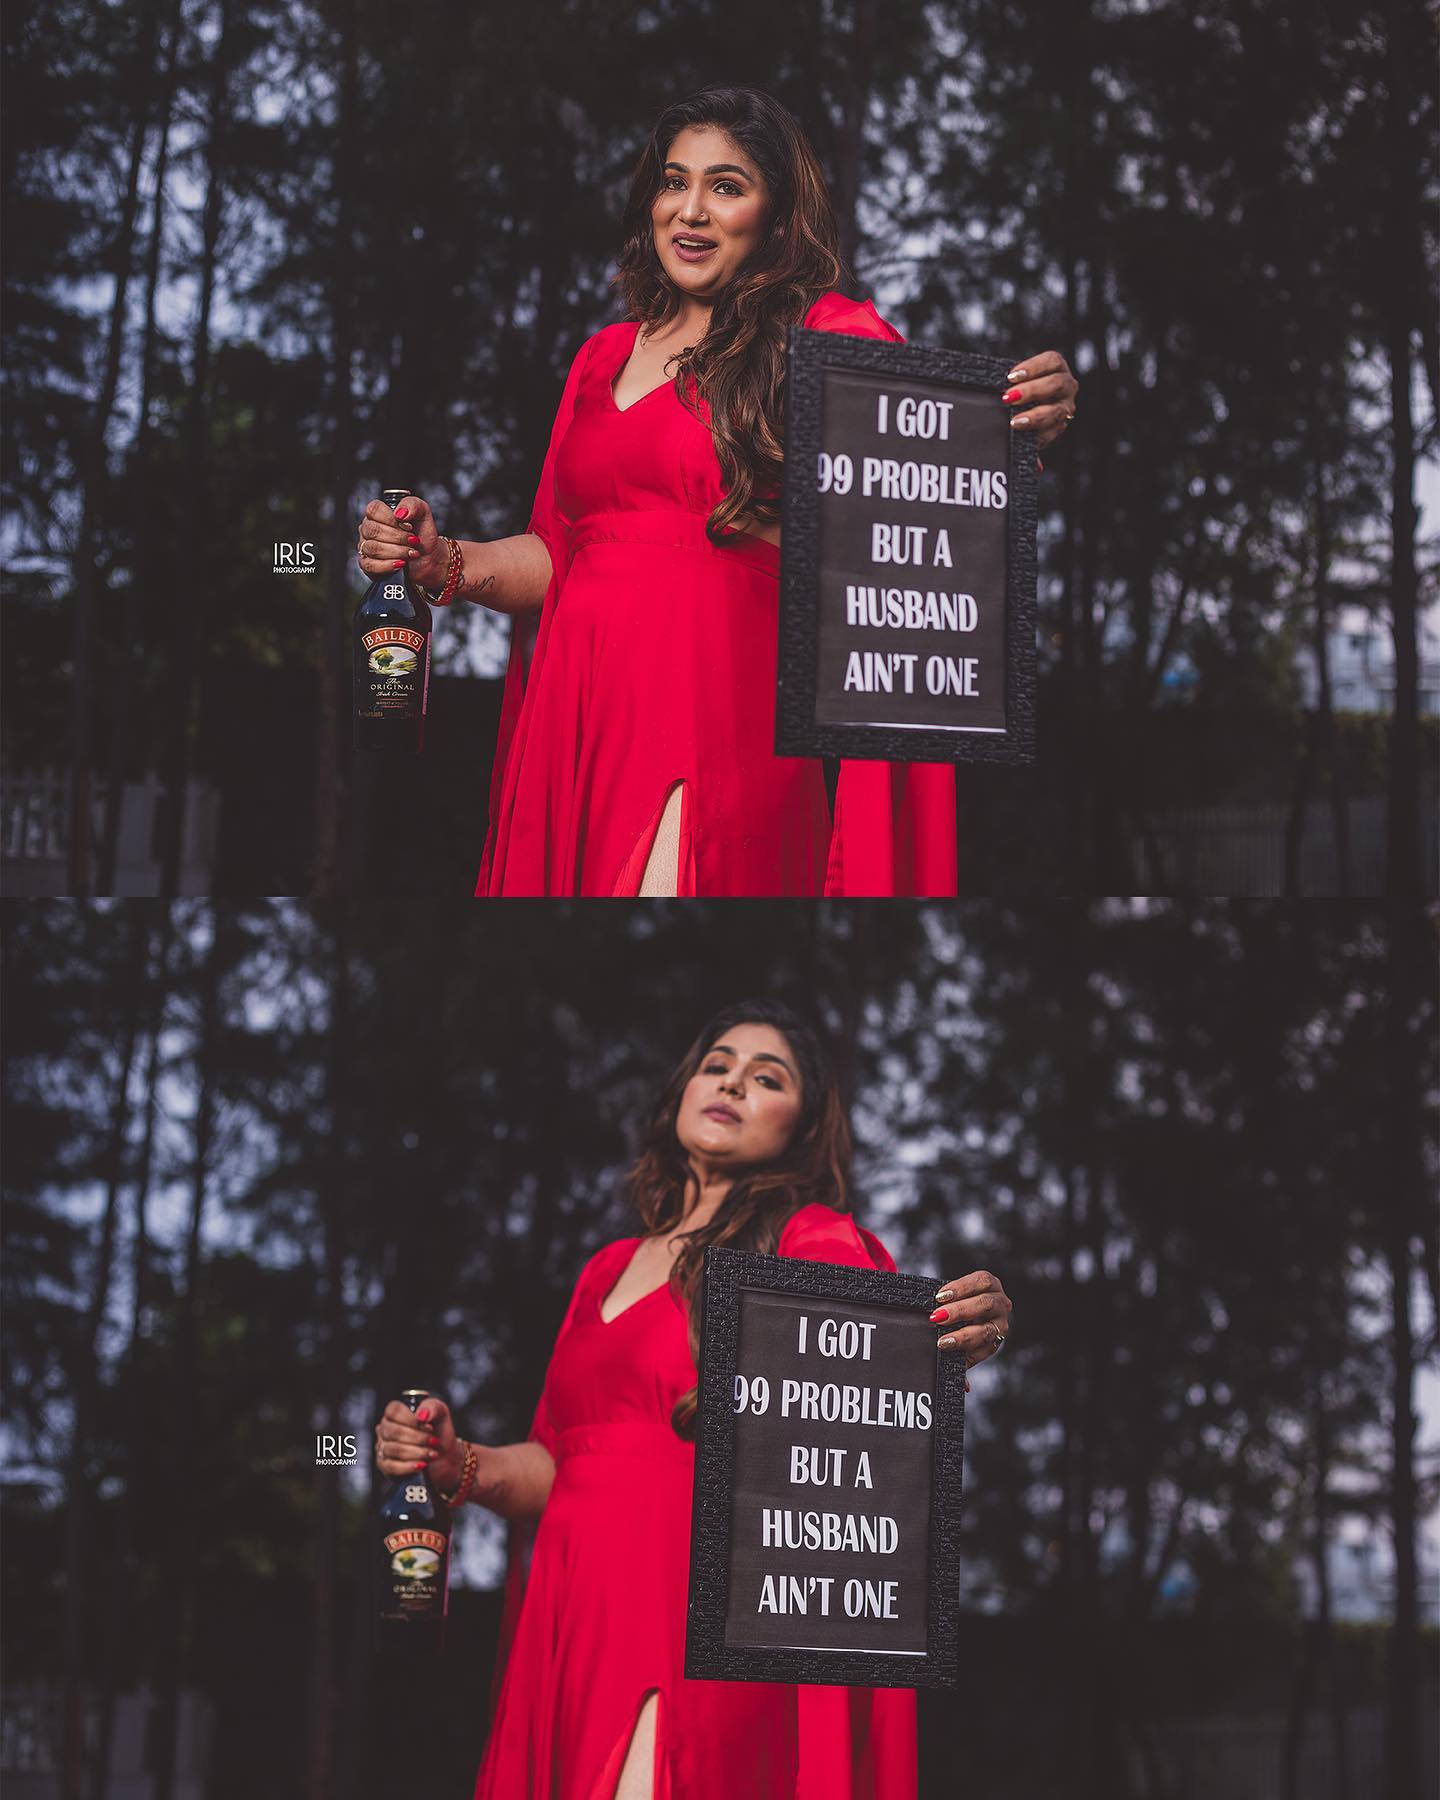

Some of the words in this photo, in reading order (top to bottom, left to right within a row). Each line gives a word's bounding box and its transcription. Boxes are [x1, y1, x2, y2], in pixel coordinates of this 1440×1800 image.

[877, 394, 889, 434] I
[896, 397, 954, 441] GOT
[817, 452, 854, 495] 99
[862, 457, 1008, 510] PROBLEMS
[871, 523, 928, 566] BUT
[933, 529, 953, 568] A
[846, 585, 978, 633] HUSBAND
[365, 630, 421, 646] BAILEYS
[370, 683, 415, 691] ORIGINAL
[843, 651, 919, 694] AIN'T
[925, 655, 980, 697] ONE
[798, 1316, 808, 1354] I
[817, 1318, 877, 1361] GOT
[733, 1374, 770, 1416] 99
[781, 1379, 933, 1431] PROBLEMS
[790, 1445, 848, 1487] BUT
[854, 1451, 874, 1489] A
[762, 1508, 899, 1555] HUSBAND
[757, 1574, 835, 1616] AIN'T
[843, 1578, 899, 1619] ONE
